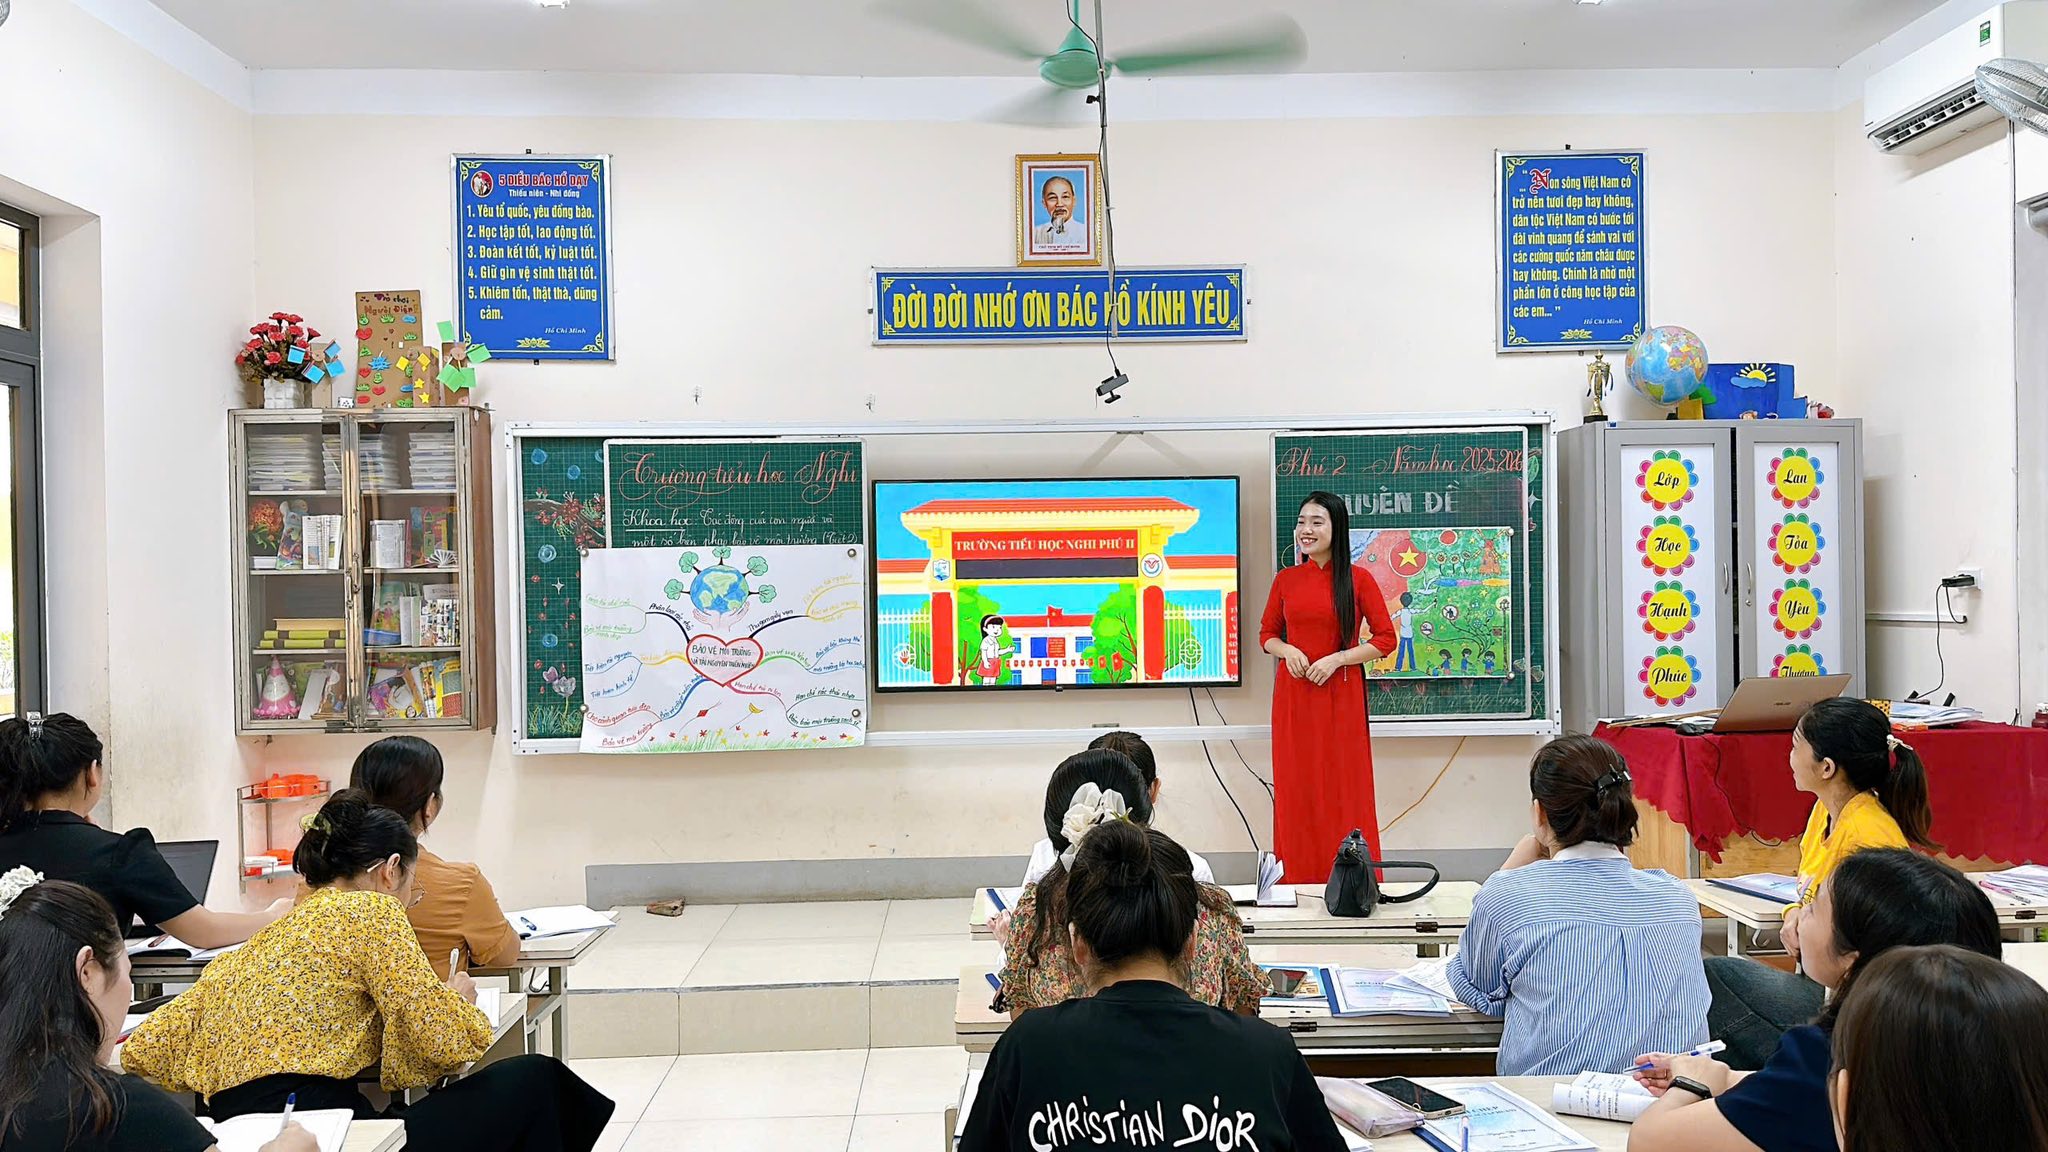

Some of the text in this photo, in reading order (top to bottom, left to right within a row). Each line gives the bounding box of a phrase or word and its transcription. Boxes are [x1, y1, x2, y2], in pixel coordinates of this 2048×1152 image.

[499, 170, 589, 189] 5 ĐIỀU BÁC HỒ DẠY
[1562, 176, 1580, 190] sông
[1583, 176, 1598, 191] Việt
[1601, 176, 1618, 188] Nam
[1621, 175, 1631, 188] có
[467, 202, 594, 219] 1. Yêu tổ quốc, yêu đồng bào.
[1513, 195, 1633, 210] trở nên tươi đẹp hay không,
[1513, 212, 1633, 229] dân tộc Việt Nam có bước tới
[467, 224, 595, 240] 2. Học tập tốt, lao động tốt.
[1513, 229, 1634, 245] đài vinh quang để sánh vai với
[468, 246, 476, 258] 3.
[479, 245, 504, 258] Đoàn
[507, 246, 523, 258] kết
[526, 244, 541, 260] tốt,
[559, 245, 578, 261] luật
[581, 244, 597, 259] tốt.
[1513, 248, 1635, 264] các cường quốc năm châu được
[468, 266, 477, 278] 4.
[481, 266, 497, 279] Giữ
[519, 267, 530, 282] vệ
[533, 266, 554, 279] sinh
[558, 266, 577, 282] thật
[580, 265, 597, 279] tốt.
[1513, 267, 1635, 282] hay không. Chính là nhờ một
[469, 284, 597, 302] 5. Khiêm tốn, thật thà, dũng
[1513, 283, 1635, 300] phần lớn ở công học tập của
[480, 305, 503, 319] cảm.
[893, 279, 1230, 328] ĐỜI ĐỜI NHỚ ƠN BÁC HỒ KÍNH YÊU
[1513, 305, 1529, 318] các
[1653, 471, 1680, 489] Lớp
[1783, 469, 1808, 484] Lan
[1423, 480, 1460, 513] ĐỀ
[954, 536, 1134, 551] TRƯỜNG TIỂU HỌC NGHI PHÚ II
[1654, 537, 1681, 554] Học
[1784, 534, 1808, 550] Tỏa
[1650, 602, 1687, 621] Hạnh
[1785, 600, 1811, 618] Yêu
[1652, 666, 1687, 685] Phúc
